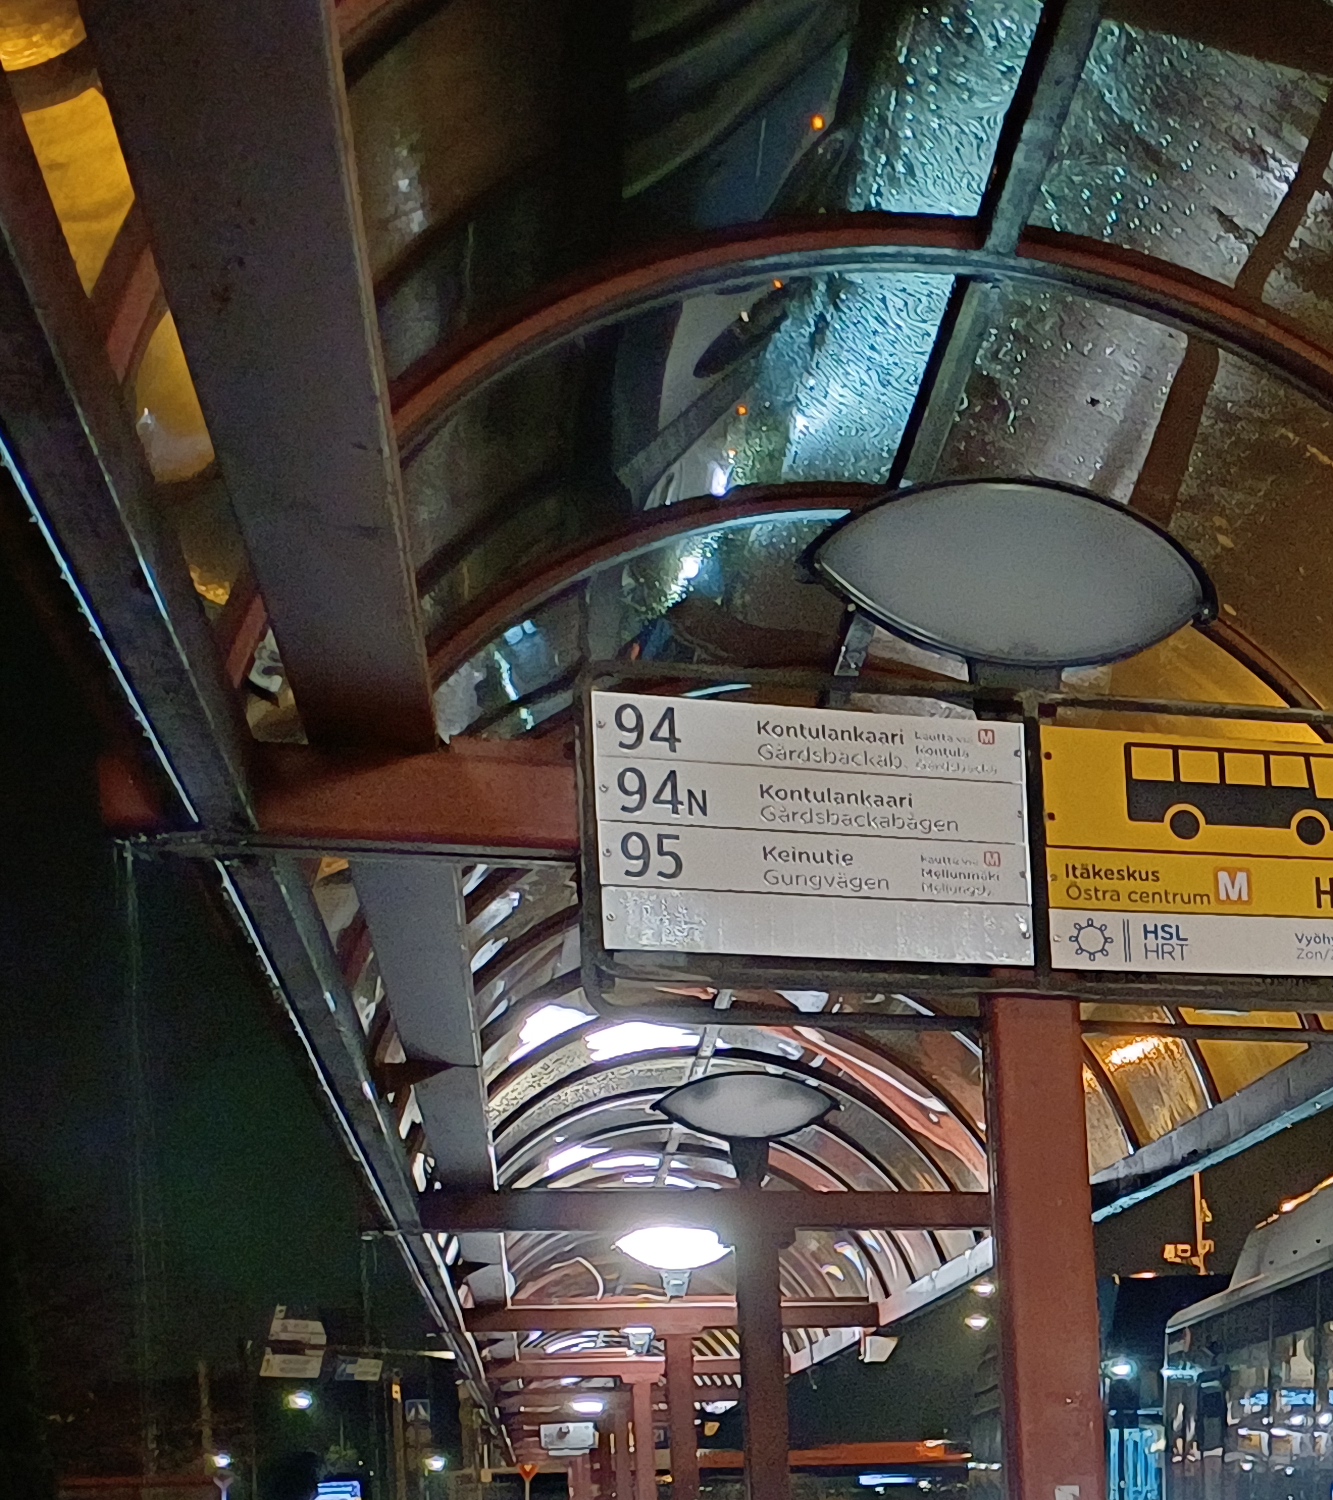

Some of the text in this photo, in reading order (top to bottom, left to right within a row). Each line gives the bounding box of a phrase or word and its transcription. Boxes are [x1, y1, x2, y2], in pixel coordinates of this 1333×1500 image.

[614, 703, 682, 753] 94
[756, 719, 905, 746] Kontulankaari
[617, 766, 708, 817] 94N
[759, 783, 913, 809] Kontulankaari
[760, 804, 959, 834] Gårdsbackabågen
[620, 831, 683, 880] 95
[762, 845, 854, 866] Keinutie
[763, 868, 890, 891] Gungvägen
[1064, 863, 1161, 883] Itäkeskus
[1066, 881, 1121, 902] Östra
[1127, 889, 1211, 906] centrum
[1142, 922, 1189, 942] HSL
[1143, 942, 1190, 962] HRT
